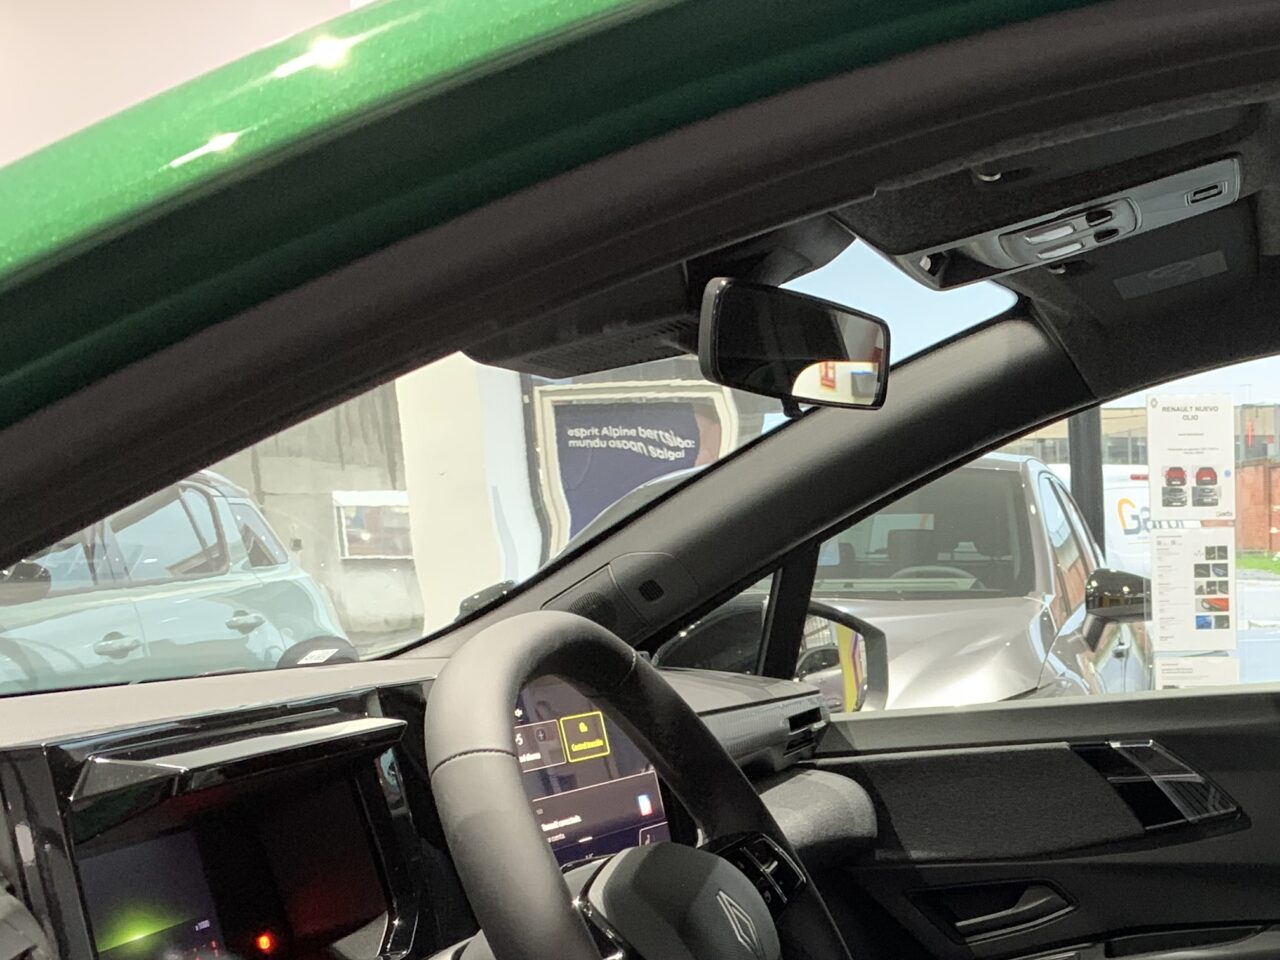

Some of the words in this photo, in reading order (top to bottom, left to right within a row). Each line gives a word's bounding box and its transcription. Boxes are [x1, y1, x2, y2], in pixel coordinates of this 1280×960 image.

[567, 427, 600, 438] esprit
[601, 426, 637, 438] Alpine
[568, 438, 607, 448] mundu
